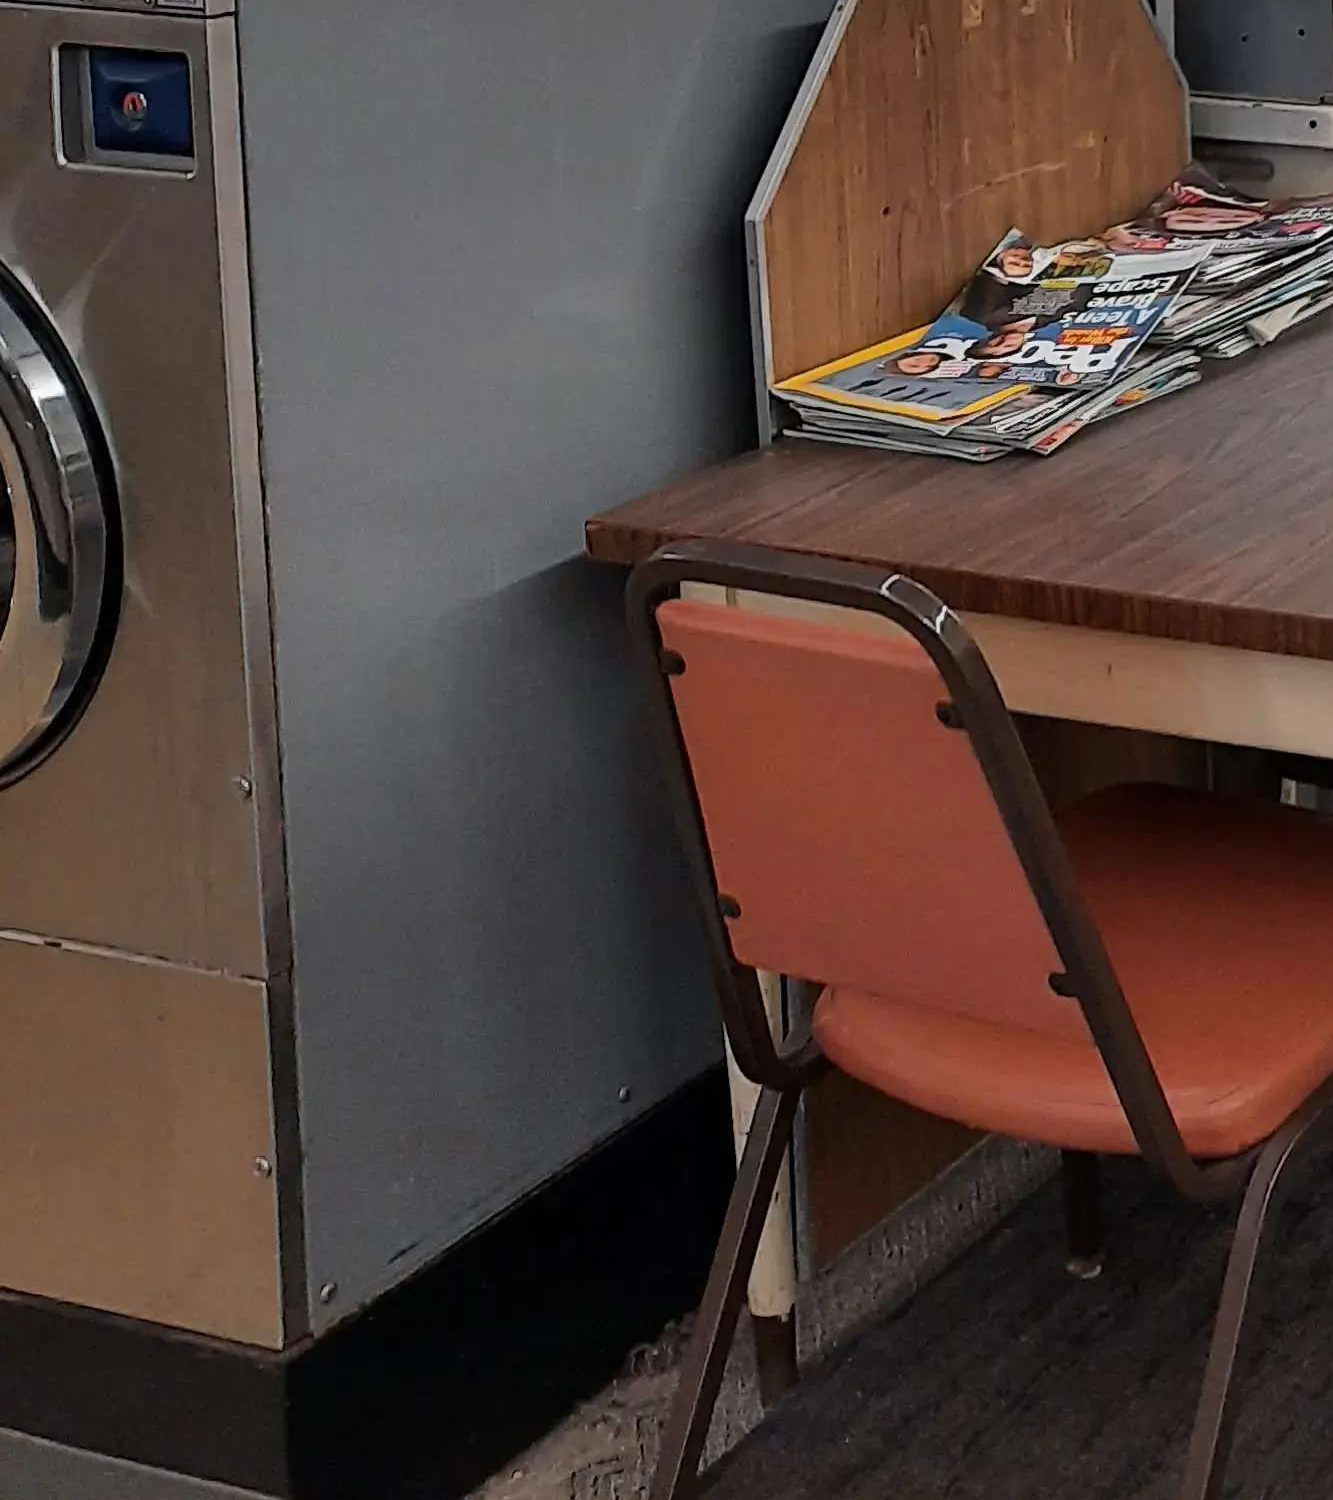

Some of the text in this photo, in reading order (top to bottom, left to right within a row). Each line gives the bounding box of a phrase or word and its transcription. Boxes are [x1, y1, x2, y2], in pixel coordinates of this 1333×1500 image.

[1092, 275, 1178, 293] Escape
[1087, 292, 1159, 309] Brave
[1058, 307, 1159, 328] A Teen's
